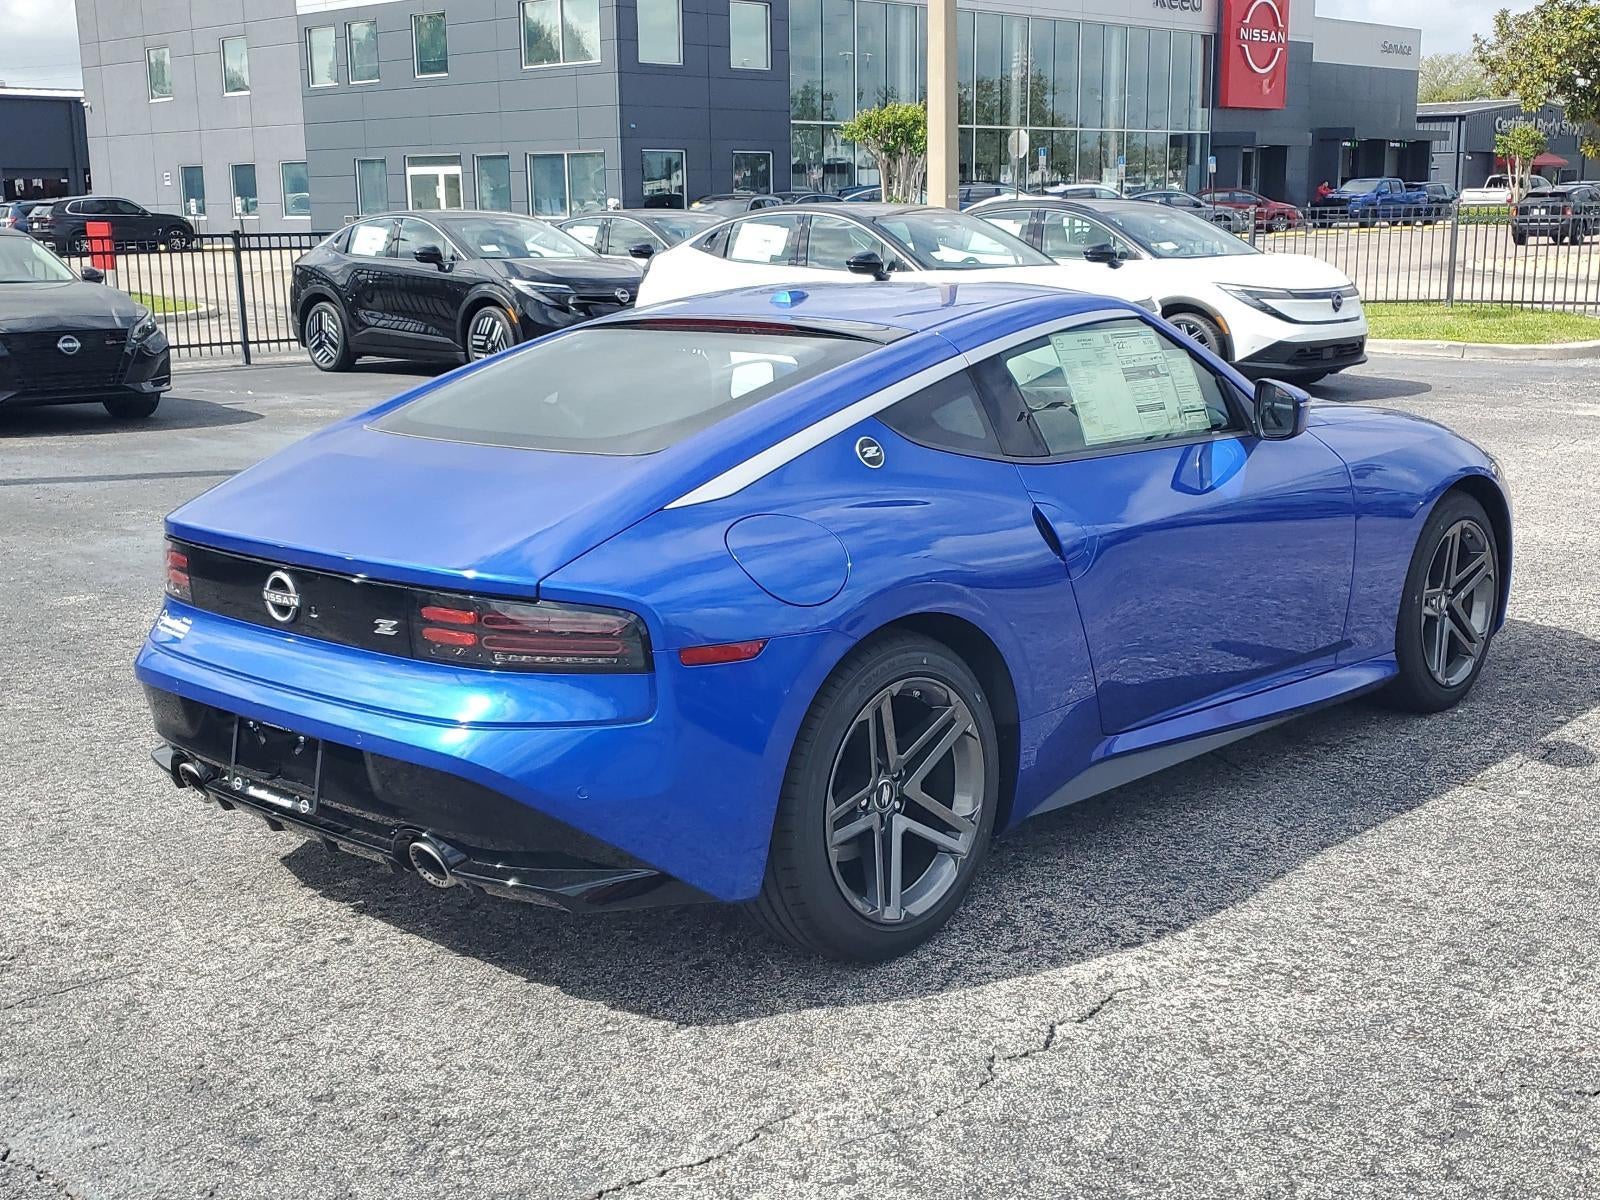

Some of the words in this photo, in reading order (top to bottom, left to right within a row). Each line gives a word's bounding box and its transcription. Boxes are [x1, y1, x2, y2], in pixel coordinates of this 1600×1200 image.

[1240, 27, 1285, 43] NISSAN
[1381, 40, 1412, 56] Service
[861, 446, 880, 458] Z
[263, 590, 299, 606] NISSAN
[374, 618, 399, 636] Z
